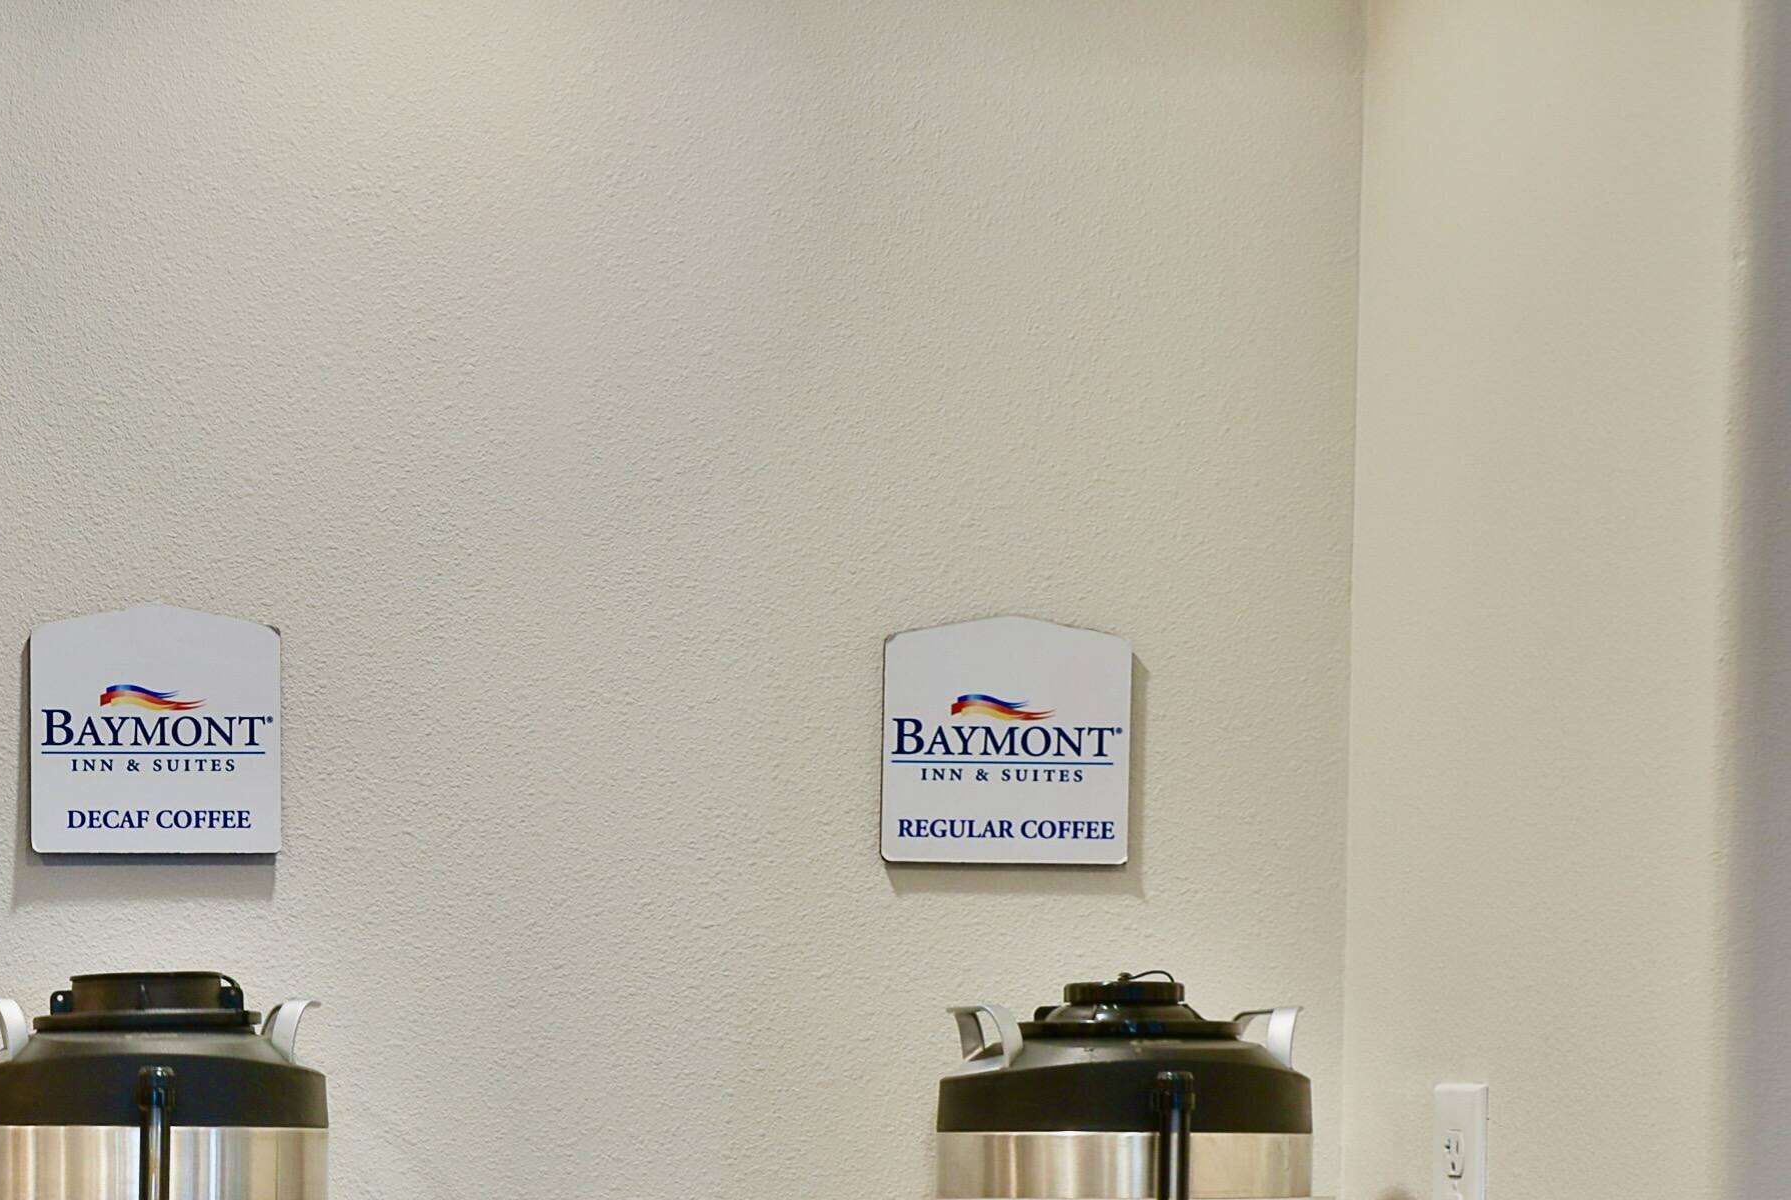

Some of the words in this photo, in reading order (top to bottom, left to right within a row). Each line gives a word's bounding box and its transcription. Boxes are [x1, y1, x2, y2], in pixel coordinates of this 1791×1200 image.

[71, 758, 114, 772] INN
[126, 758, 140, 772] &
[152, 758, 236, 772] SUITES
[920, 767, 963, 781] INN
[975, 768, 989, 782] &
[1001, 768, 1084, 782] SUITES
[66, 810, 150, 829] DECAF
[155, 810, 252, 829] COFFEE
[897, 819, 1015, 839] REGULAR
[1020, 820, 1115, 840] COFFEE
